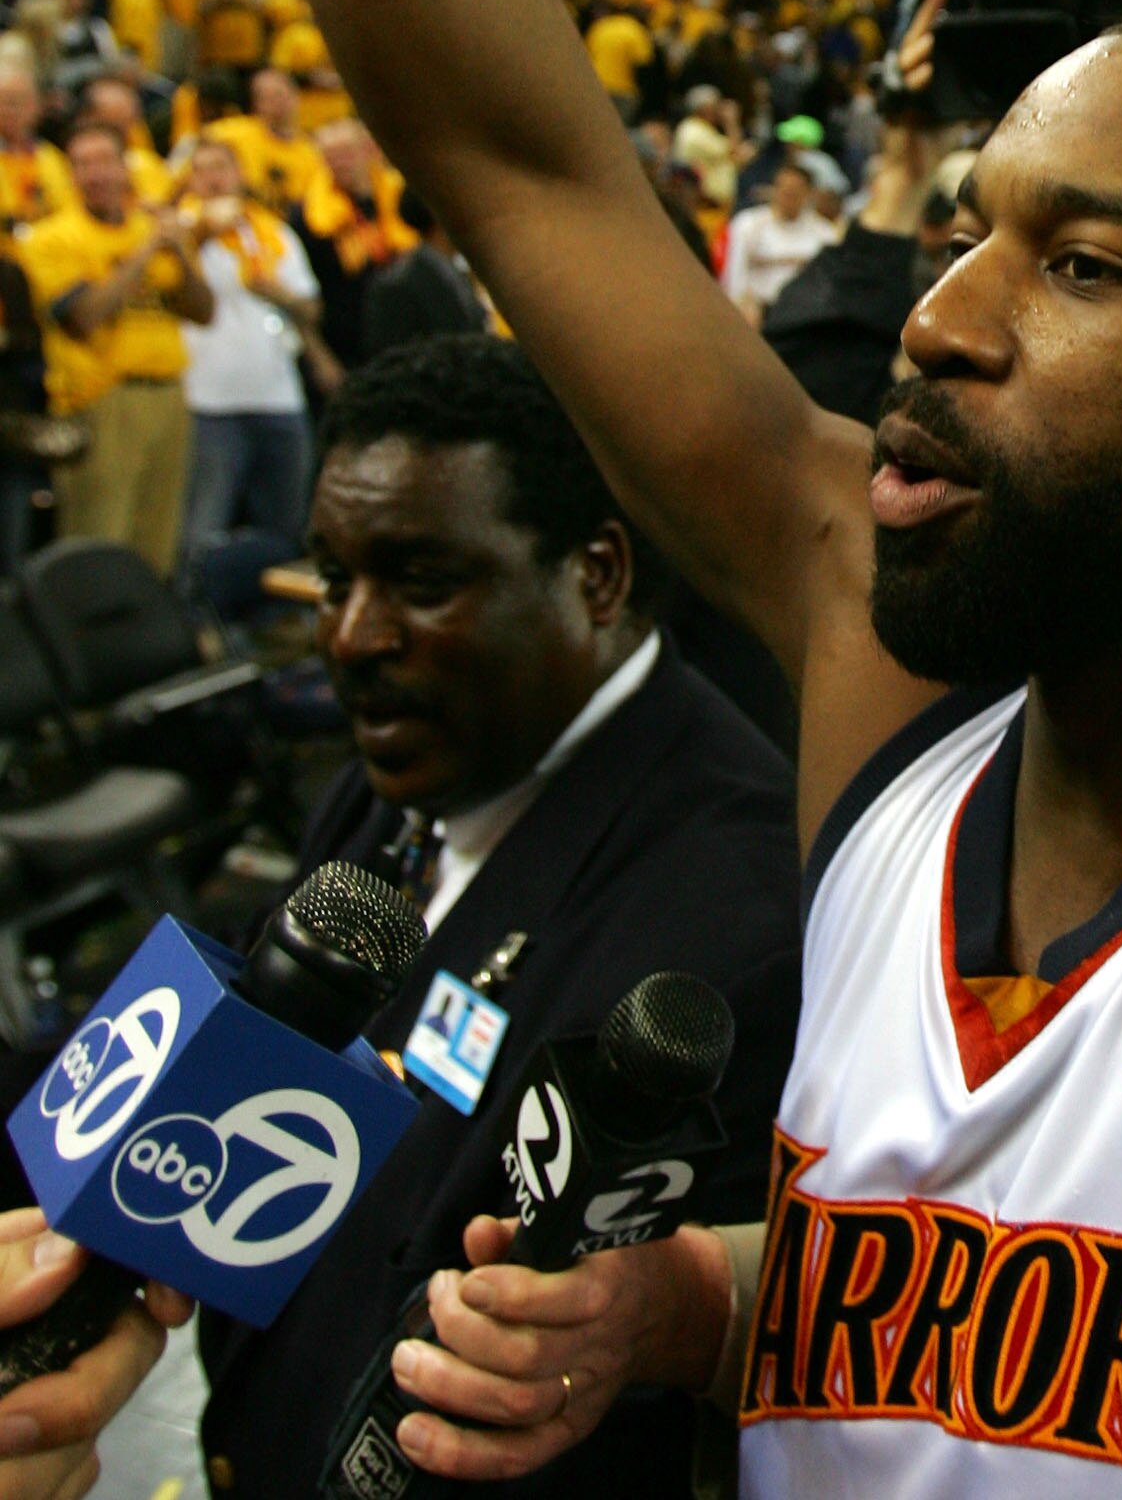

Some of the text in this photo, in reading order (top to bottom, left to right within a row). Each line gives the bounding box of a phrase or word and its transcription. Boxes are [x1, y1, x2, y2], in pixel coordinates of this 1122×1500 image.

[54, 986, 181, 1161] abc 7
[128, 1088, 361, 1267] abc 7
[501, 1142, 537, 1227] KTVU
[583, 1159, 695, 1233] 2
[571, 1224, 655, 1256] KTVU
